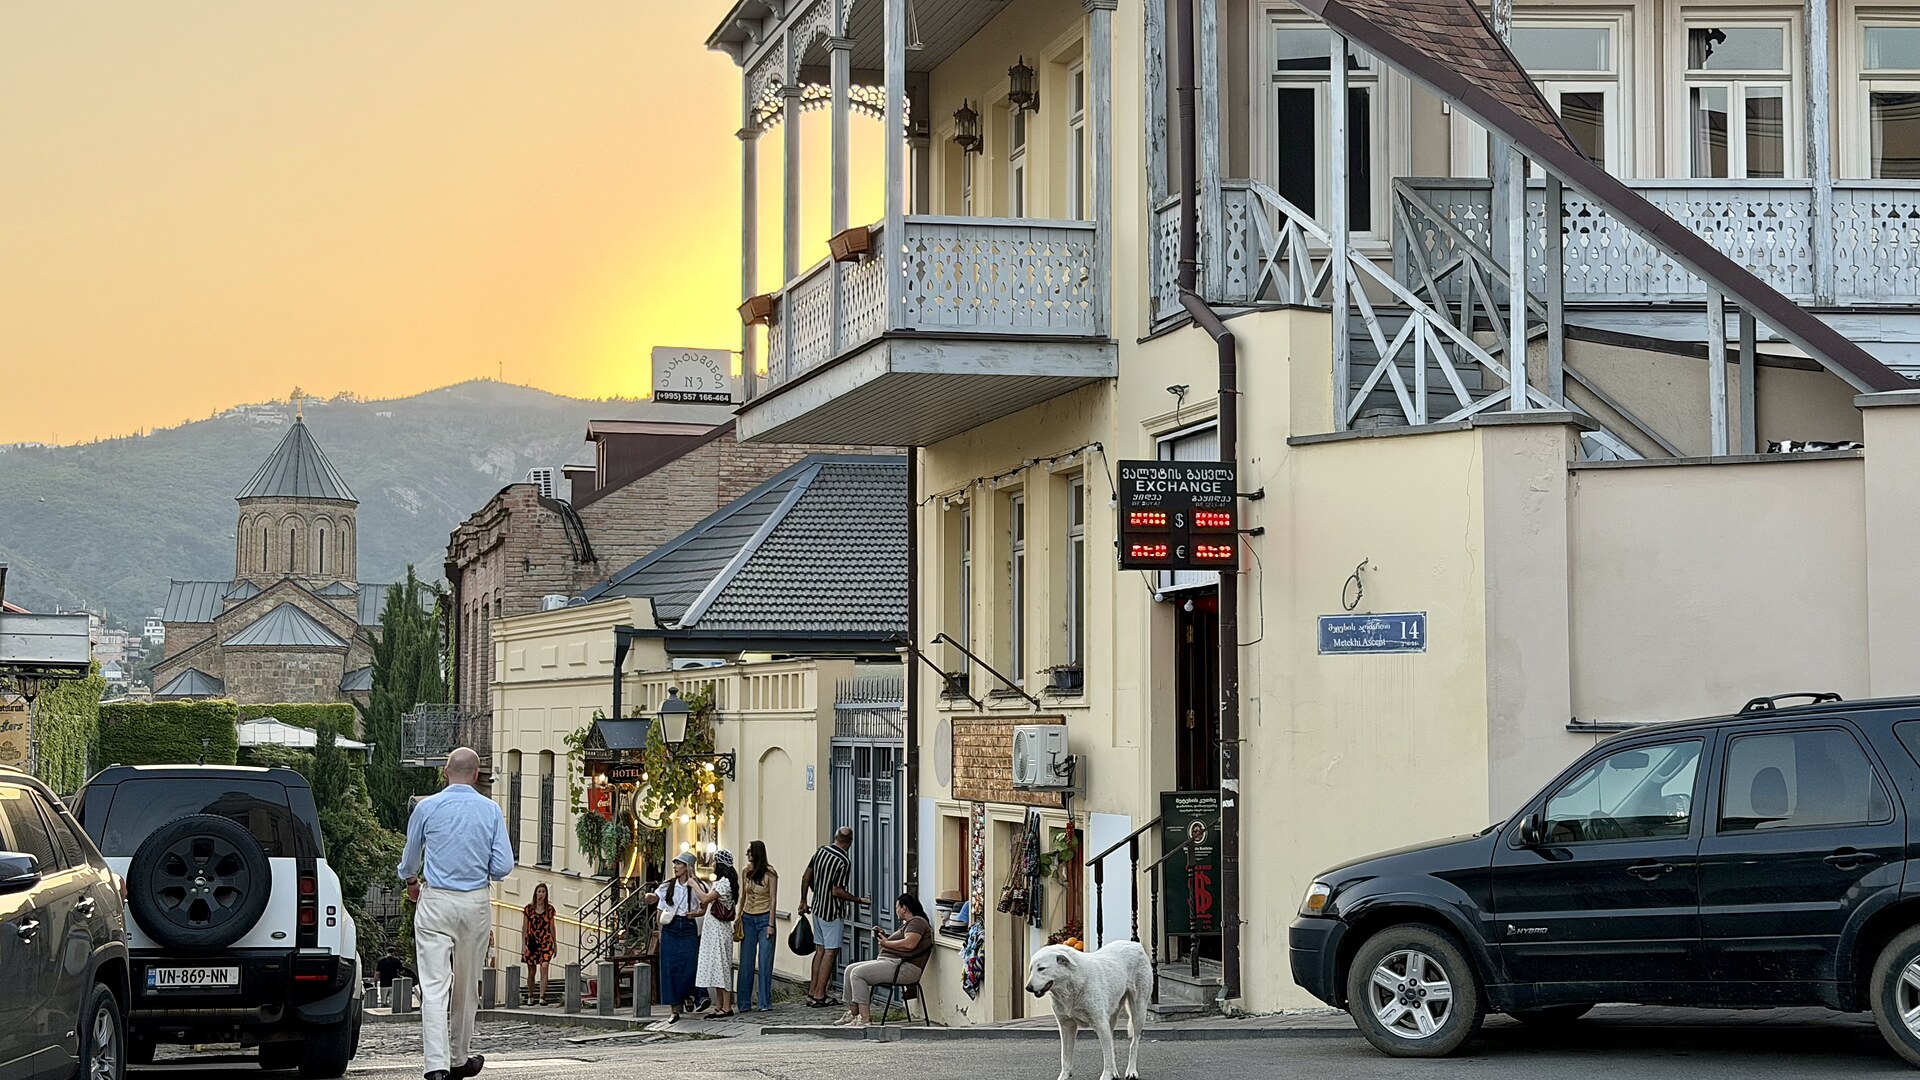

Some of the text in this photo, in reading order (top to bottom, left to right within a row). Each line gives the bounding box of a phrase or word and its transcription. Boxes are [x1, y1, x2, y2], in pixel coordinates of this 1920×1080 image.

[656, 392, 729, 402] (+995) 557 166-464
[1122, 467, 1234, 482] ვალუტის გაცვლა
[1136, 480, 1222, 493] EXCHANGE
[1175, 513, 1184, 528] $
[1176, 545, 1185, 559] €
[1400, 620, 1420, 640] 14
[1333, 637, 1361, 647] Metekhi
[612, 769, 640, 778] HOTEL
[159, 969, 228, 984] VN-869-NN
